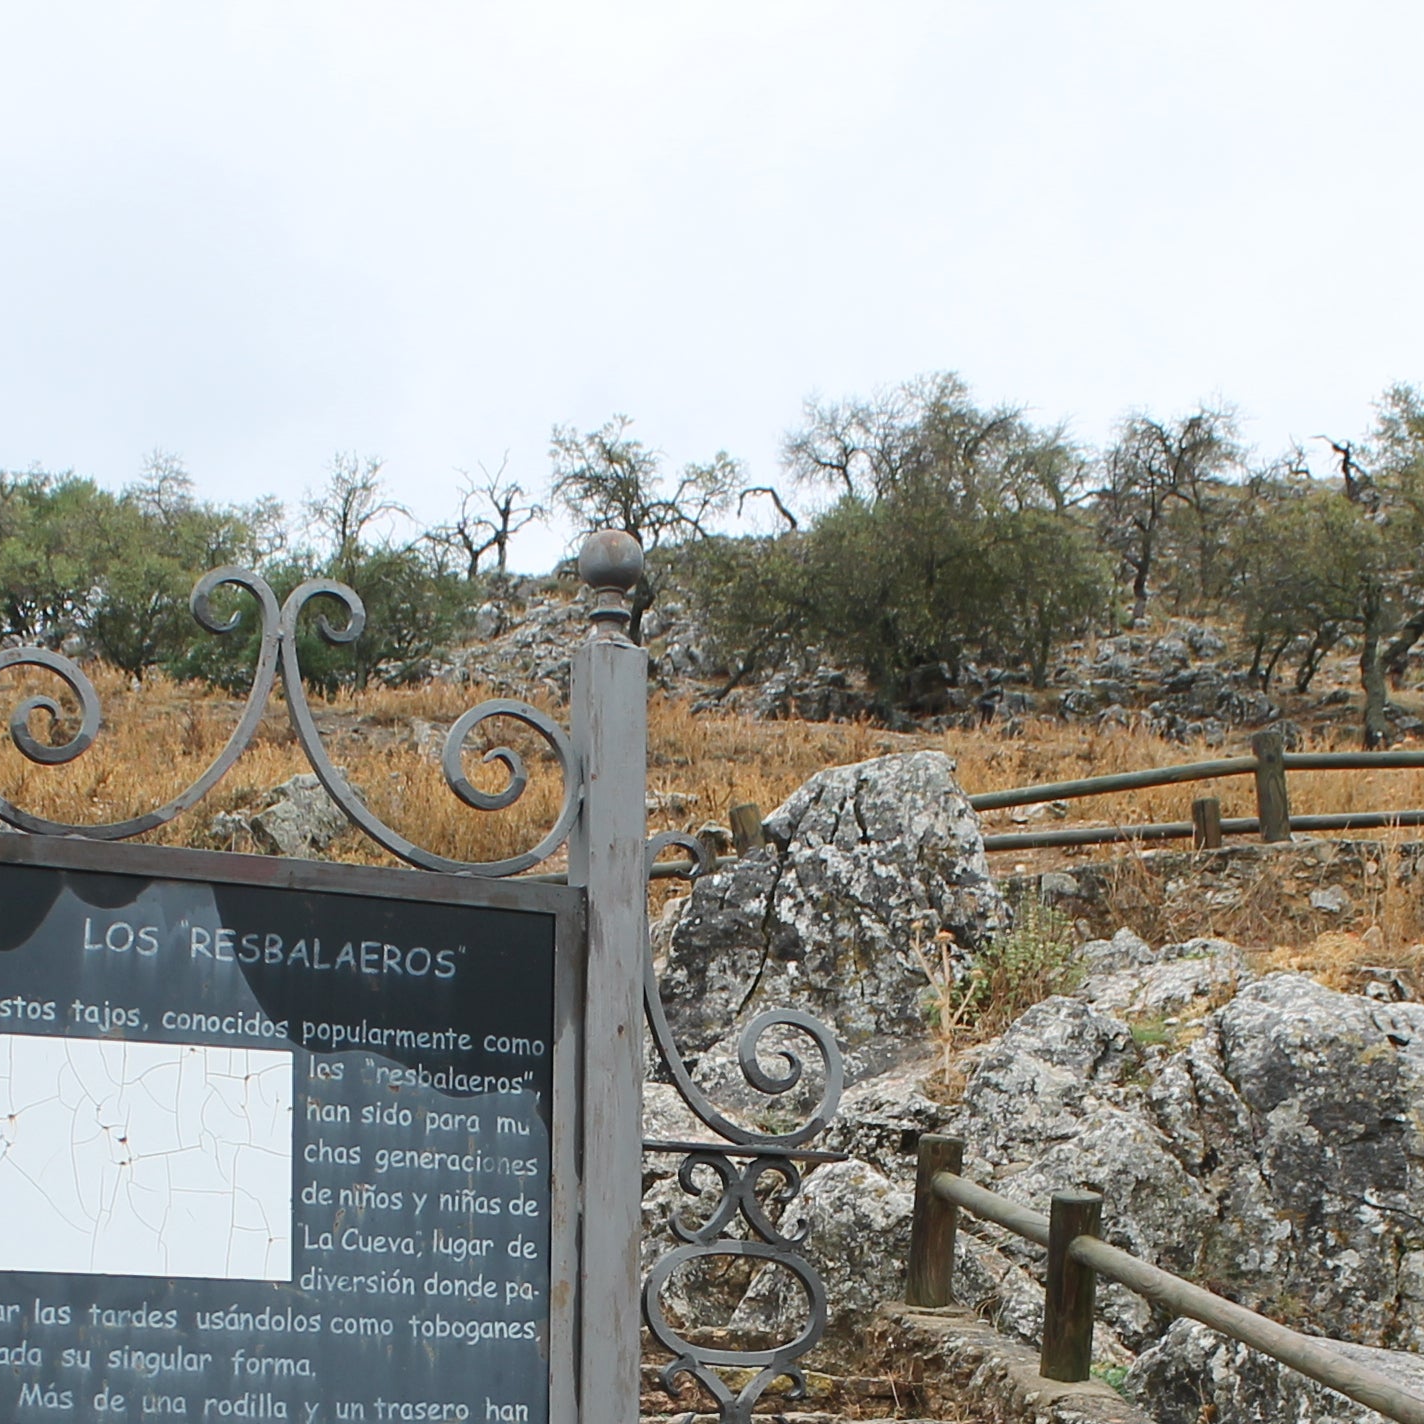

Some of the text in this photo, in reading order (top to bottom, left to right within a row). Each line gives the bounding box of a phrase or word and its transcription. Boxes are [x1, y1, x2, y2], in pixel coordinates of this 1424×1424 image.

[83, 917, 466, 979] LOS "RESBALAEROS"
[73, 998, 149, 1032] tajos,
[161, 1011, 288, 1039] conocidos
[302, 1020, 473, 1052] popularmente
[484, 1032, 545, 1057] como
[309, 1054, 541, 1099] los "resbalaeros",
[306, 1097, 351, 1124] han
[361, 1100, 413, 1127] sido
[424, 1112, 480, 1136] para
[304, 1139, 538, 1176] chas generaciones
[301, 1181, 539, 1217] de niños y niñas de
[432, 1229, 493, 1261] lugar
[508, 1234, 538, 1260] de
[300, 1264, 540, 1304] diversión donde pa-
[34, 1298, 71, 1325] las
[89, 1302, 177, 1329] tardes
[196, 1304, 322, 1333] usándolos
[330, 1315, 393, 1336] como
[410, 1315, 541, 1344] toboganes,
[62, 1347, 91, 1369] su
[107, 1344, 212, 1375] singular
[231, 1350, 317, 1377] forma.
[18, 1383, 528, 1424] Más de una rodilla y un trasero han
